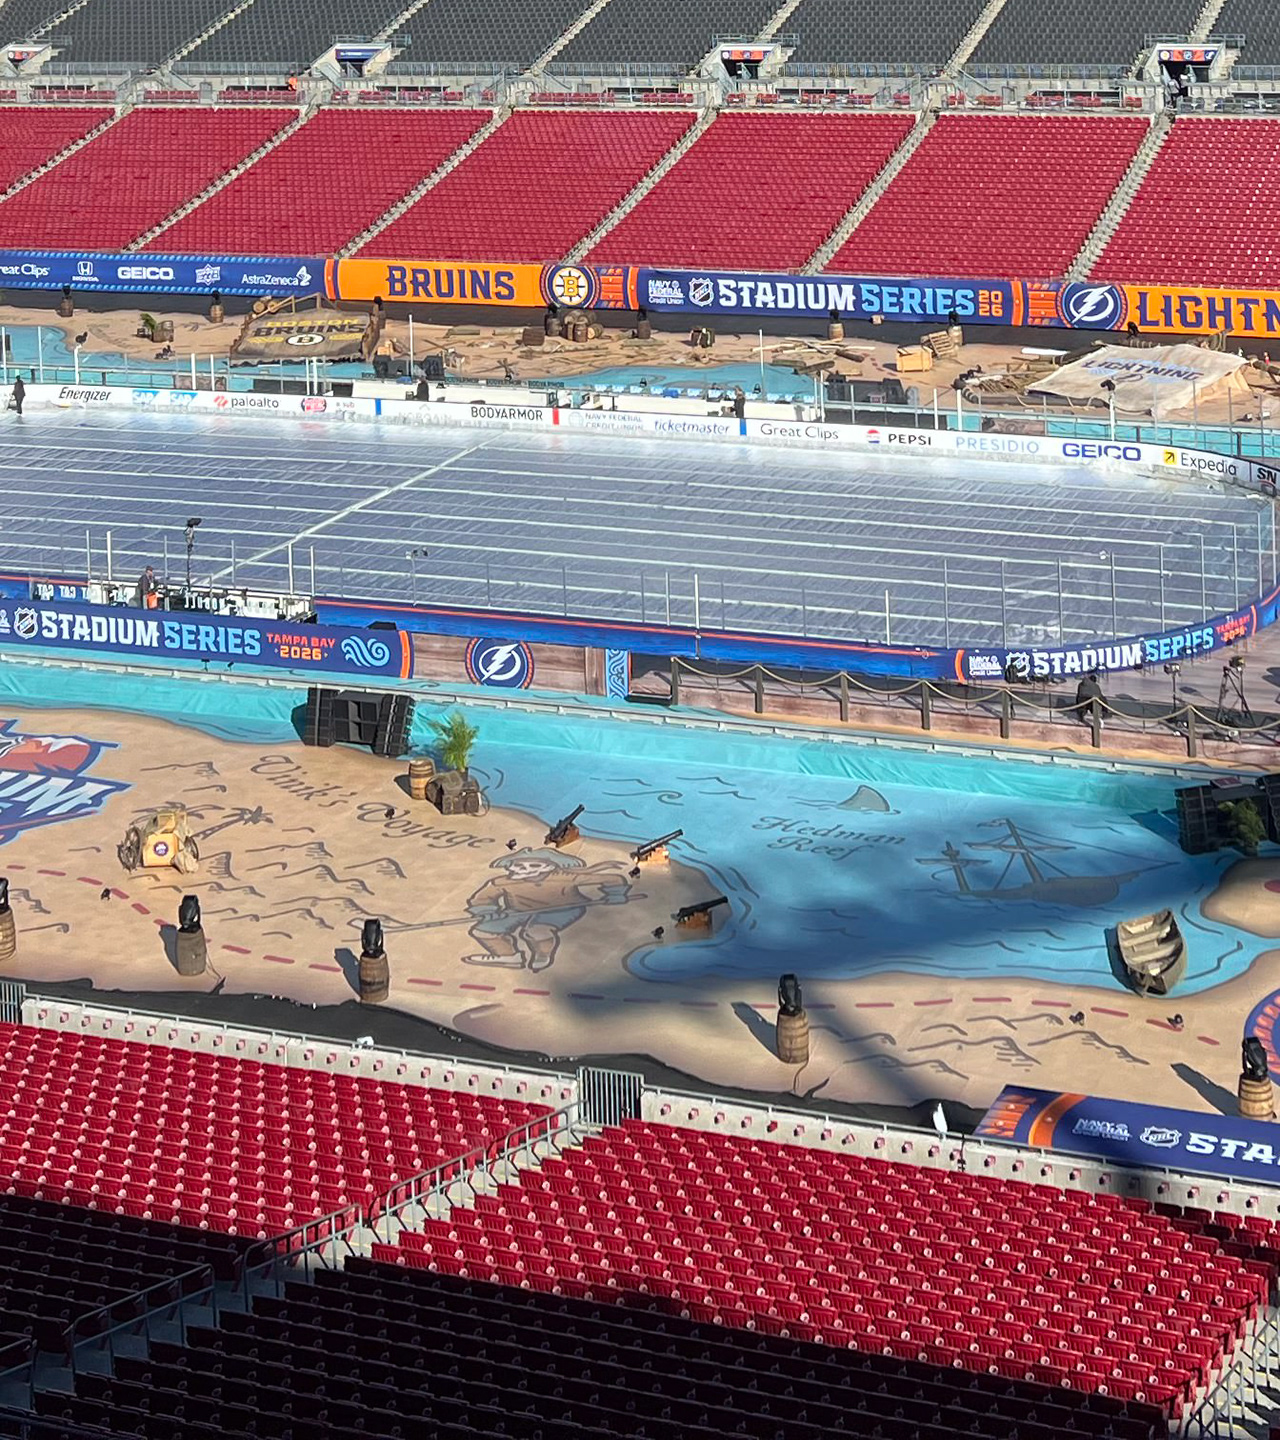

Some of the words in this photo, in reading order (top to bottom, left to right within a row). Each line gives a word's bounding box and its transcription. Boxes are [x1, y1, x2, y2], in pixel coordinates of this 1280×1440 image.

[20, 263, 50, 278] Clips
[117, 267, 175, 280] GEICO
[242, 273, 299, 287] AstraZeneca
[386, 265, 516, 301] BRUINS
[717, 278, 856, 312] STADIUM
[860, 282, 976, 316] SERIES
[979, 290, 1003, 302] 20
[979, 304, 1003, 317] 26
[252, 323, 367, 336] BRUINS
[1083, 359, 1204, 381] LIGHTNING
[59, 386, 111, 402] Energizer
[231, 398, 279, 410] paloalto
[471, 407, 543, 421] BODYARMOR
[654, 414, 730, 434] ticketmaster
[760, 423, 802, 438] Great
[805, 424, 839, 440] Clips
[889, 433, 932, 446] PEPSI
[956, 436, 1040, 454] PRESIDIO
[1062, 443, 1141, 462] GEICO
[1181, 452, 1237, 477] Expedia
[1257, 466, 1277, 485] SN
[41, 610, 161, 648] STADIUM
[164, 621, 261, 656] SERIES
[267, 632, 309, 646] TAMPA
[311, 637, 336, 649] BAY
[280, 645, 322, 660] 2026
[1034, 643, 1143, 676] STADIUM
[357, 801, 496, 850] Voyage
[752, 815, 906, 845] Hedman
[767, 836, 874, 862] Reef
